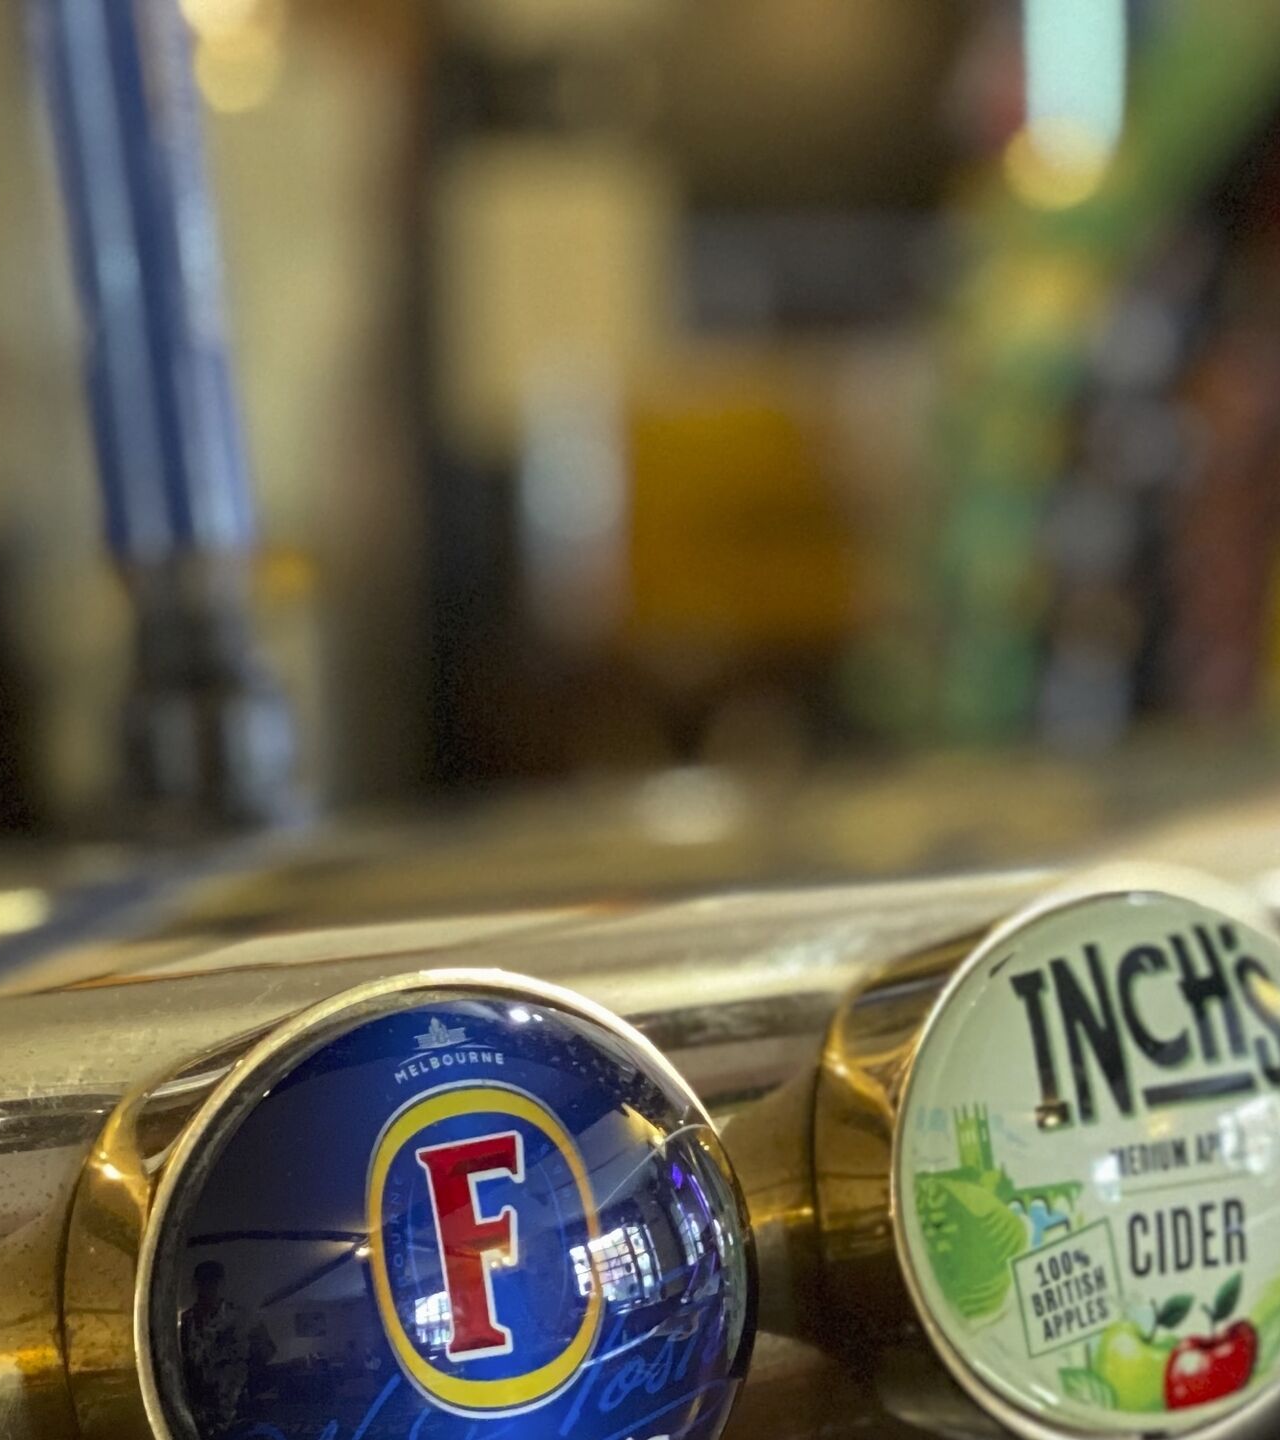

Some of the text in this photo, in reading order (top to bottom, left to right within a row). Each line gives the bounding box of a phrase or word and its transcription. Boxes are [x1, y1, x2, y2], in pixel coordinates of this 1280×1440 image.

[394, 1051, 505, 1085] MELBOURNE
[416, 1131, 525, 1362] F
[1128, 1197, 1247, 1278] CIDER
[1031, 1264, 1108, 1318] BRITISH
[1035, 1248, 1091, 1288] 100%
[1043, 1297, 1109, 1342] APPLES
